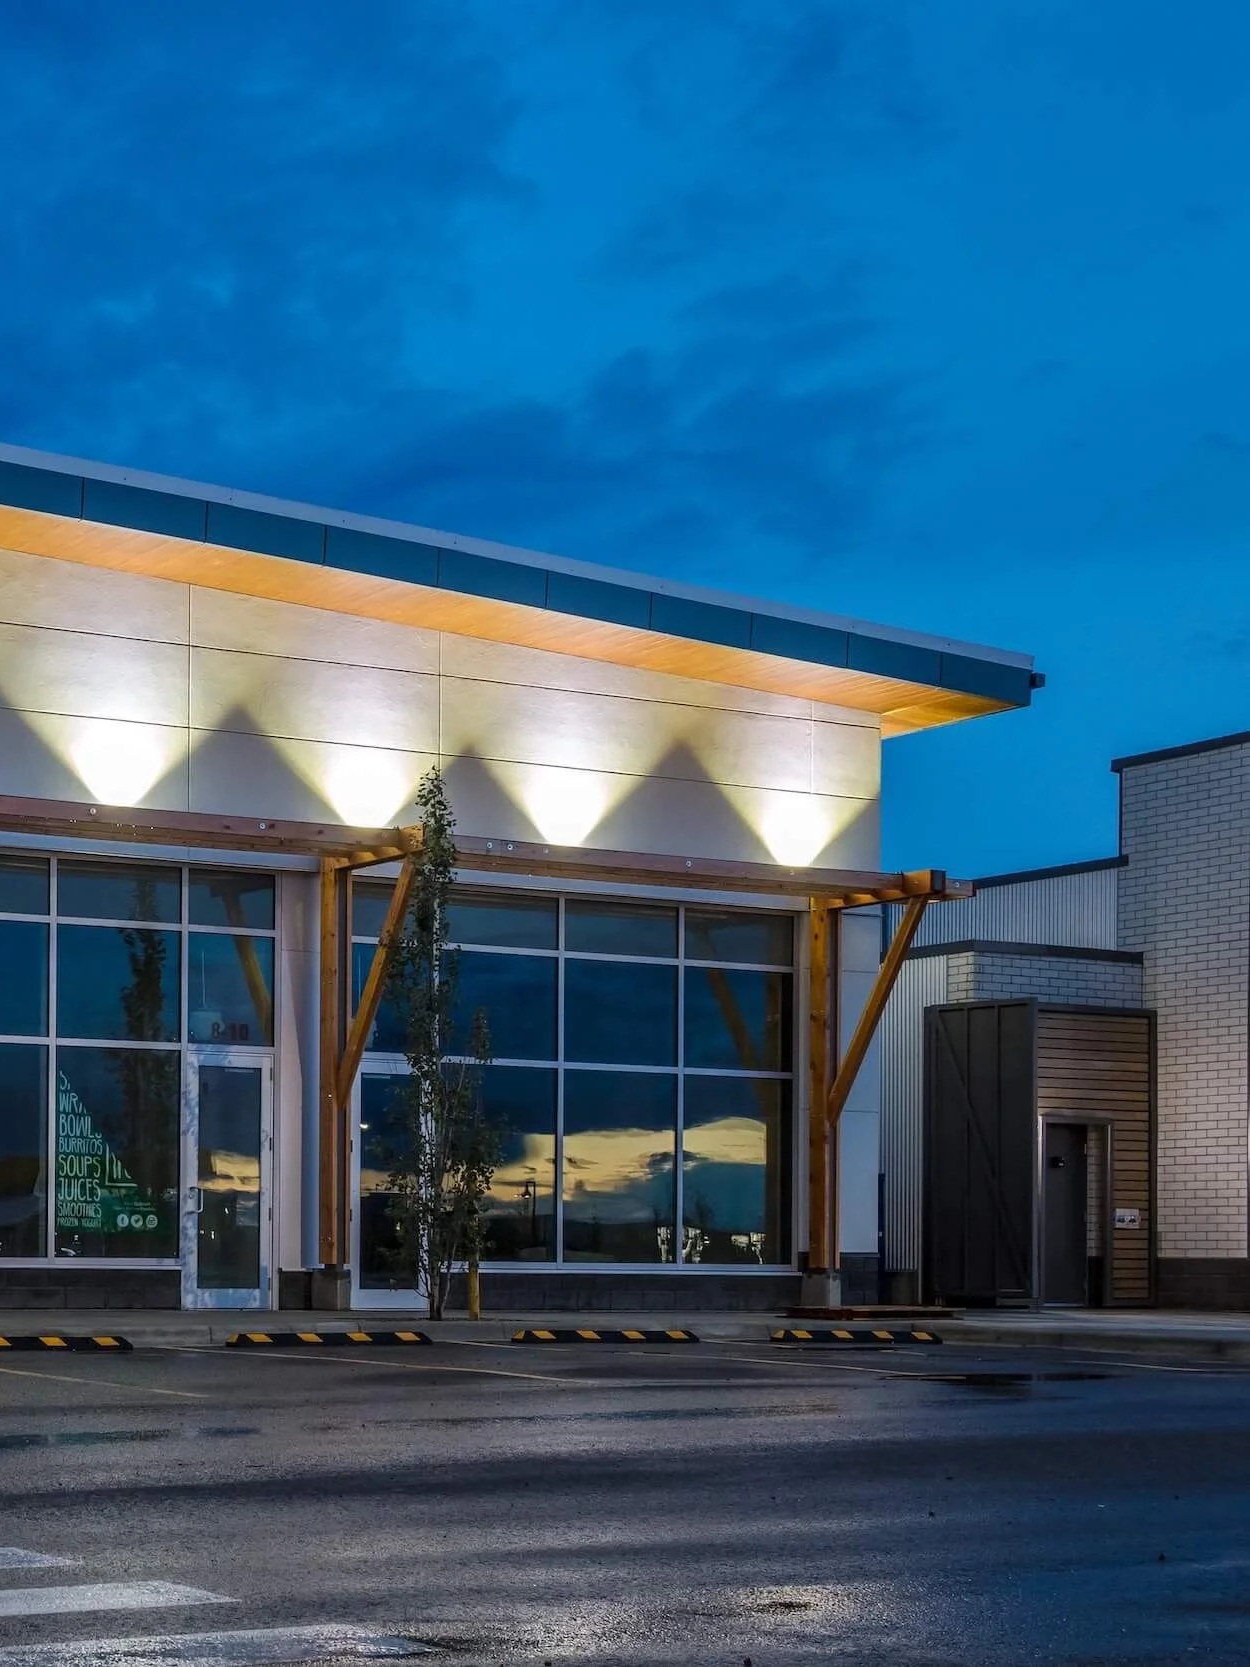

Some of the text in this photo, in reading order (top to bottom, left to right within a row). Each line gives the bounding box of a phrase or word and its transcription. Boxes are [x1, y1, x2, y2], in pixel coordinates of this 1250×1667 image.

[59, 1114, 102, 1138] BOWL
[58, 1138, 102, 1155] BURRITOS
[58, 1155, 100, 1178] SOUPS
[58, 1179, 101, 1201] JUICES
[57, 1201, 102, 1218] SMOOTHIES
